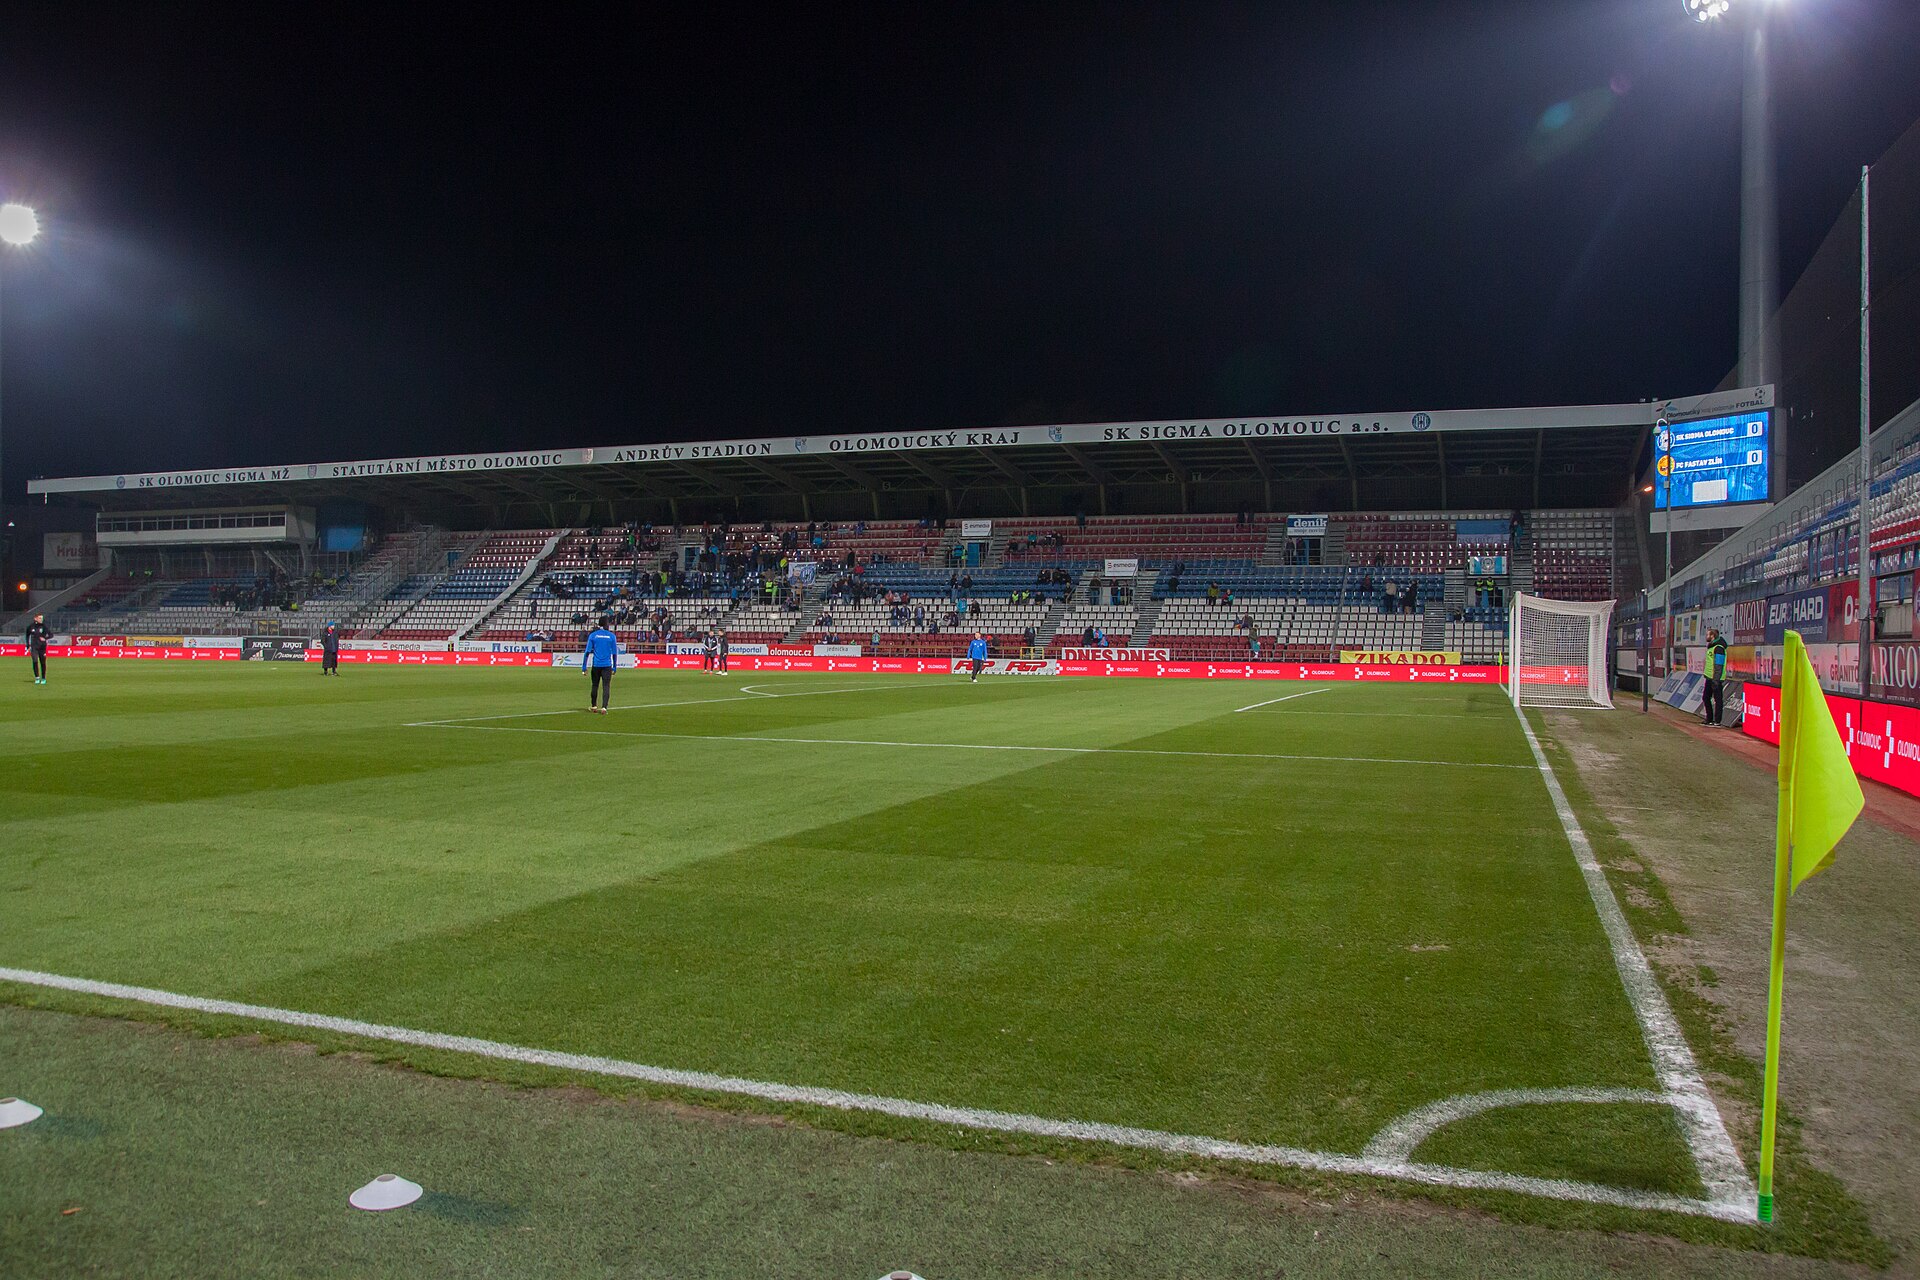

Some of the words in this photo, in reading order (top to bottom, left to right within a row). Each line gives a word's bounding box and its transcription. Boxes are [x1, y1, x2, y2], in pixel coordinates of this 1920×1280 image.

[1735, 399, 1764, 409] FOTBAL
[1103, 427, 1131, 440] SK
[1140, 424, 1213, 439] SIGMA
[1222, 420, 1341, 437] OLOMOUC
[1352, 421, 1389, 433] a.s.
[1676, 433, 1685, 441] SK
[1685, 431, 1704, 440] SIGMA
[1704, 427, 1735, 438] OLOMOUC
[1751, 423, 1758, 434] 0
[829, 431, 958, 451] OLOMOUCKÝ
[966, 431, 1020, 446] KRAJ
[614, 445, 684, 462] ANDRŮV
[691, 443, 772, 458] STADION
[1684, 459, 1708, 468] FASTAV
[1751, 452, 1758, 462] 0
[332, 458, 421, 477] STATUTÁRNÍ
[427, 457, 477, 472] MĚSTO
[483, 453, 562, 468] OLOMOUC
[139, 477, 154, 487] SK
[158, 473, 220, 486] OLOMOUC
[225, 471, 266, 482] SIGMA
[271, 467, 290, 480] MŽ
[1734, 600, 1766, 631] ARIGONE
[503, 645, 536, 653] SIGMA
[769, 647, 812, 657] olomouc.cz
[1064, 648, 1113, 661] DNES
[1116, 648, 1167, 661] DNES
[1353, 653, 1446, 665] ZIKADO
[1829, 662, 1860, 684] GRANITO
[1870, 645, 1920, 690] ARIGO
[1856, 730, 1882, 751] OLOMOUC
[1897, 739, 1920, 762] OLOMOU
